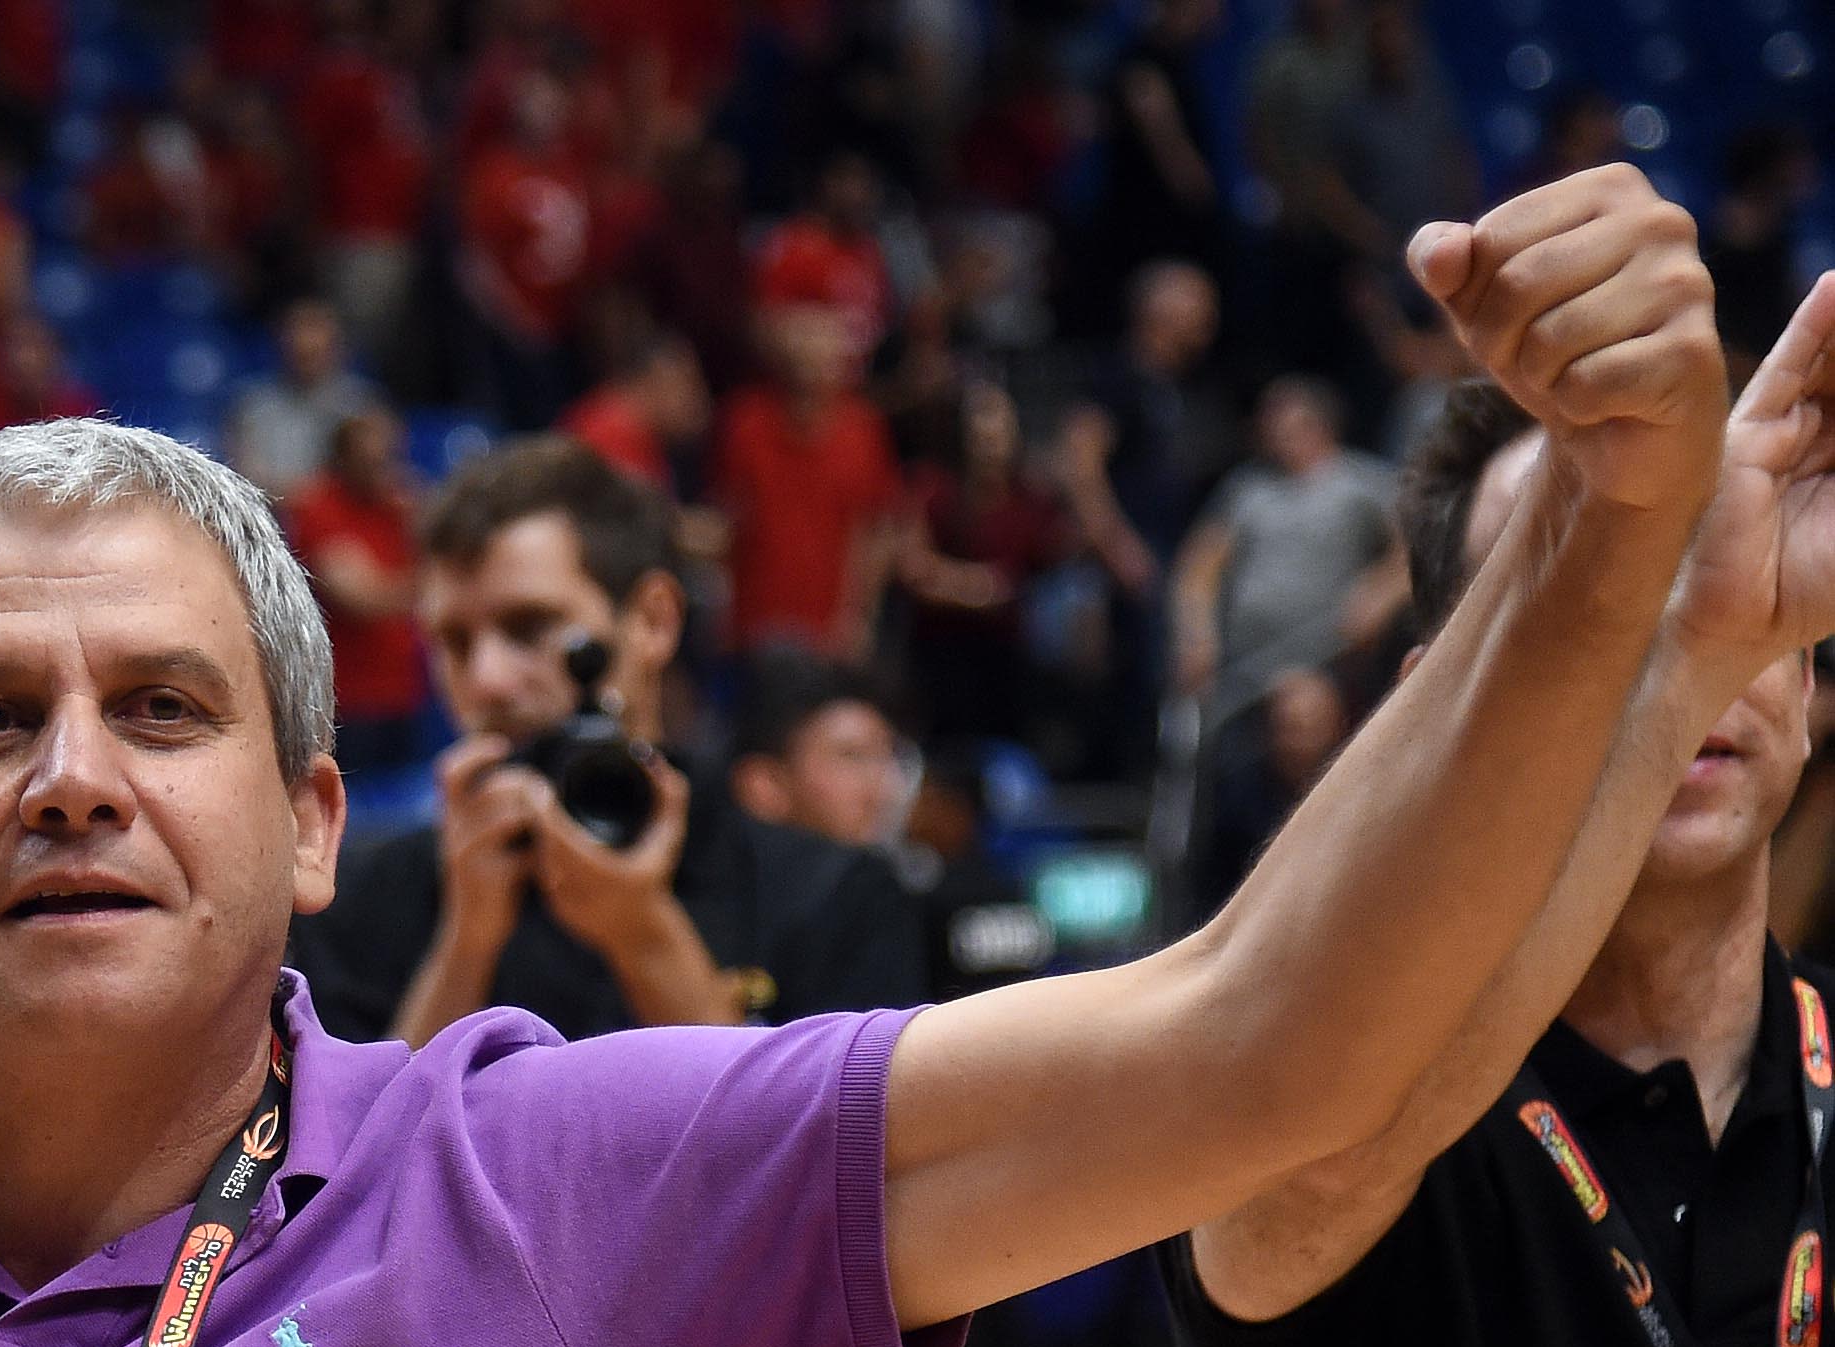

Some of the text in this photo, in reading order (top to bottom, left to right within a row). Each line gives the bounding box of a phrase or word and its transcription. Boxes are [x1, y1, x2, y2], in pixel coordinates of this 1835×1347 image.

[220, 1154, 250, 1199] מנהלת
[231, 1161, 258, 1199] הליגה
[162, 1240, 222, 1343] Winner סל
[179, 1258, 199, 1289] ליגת
